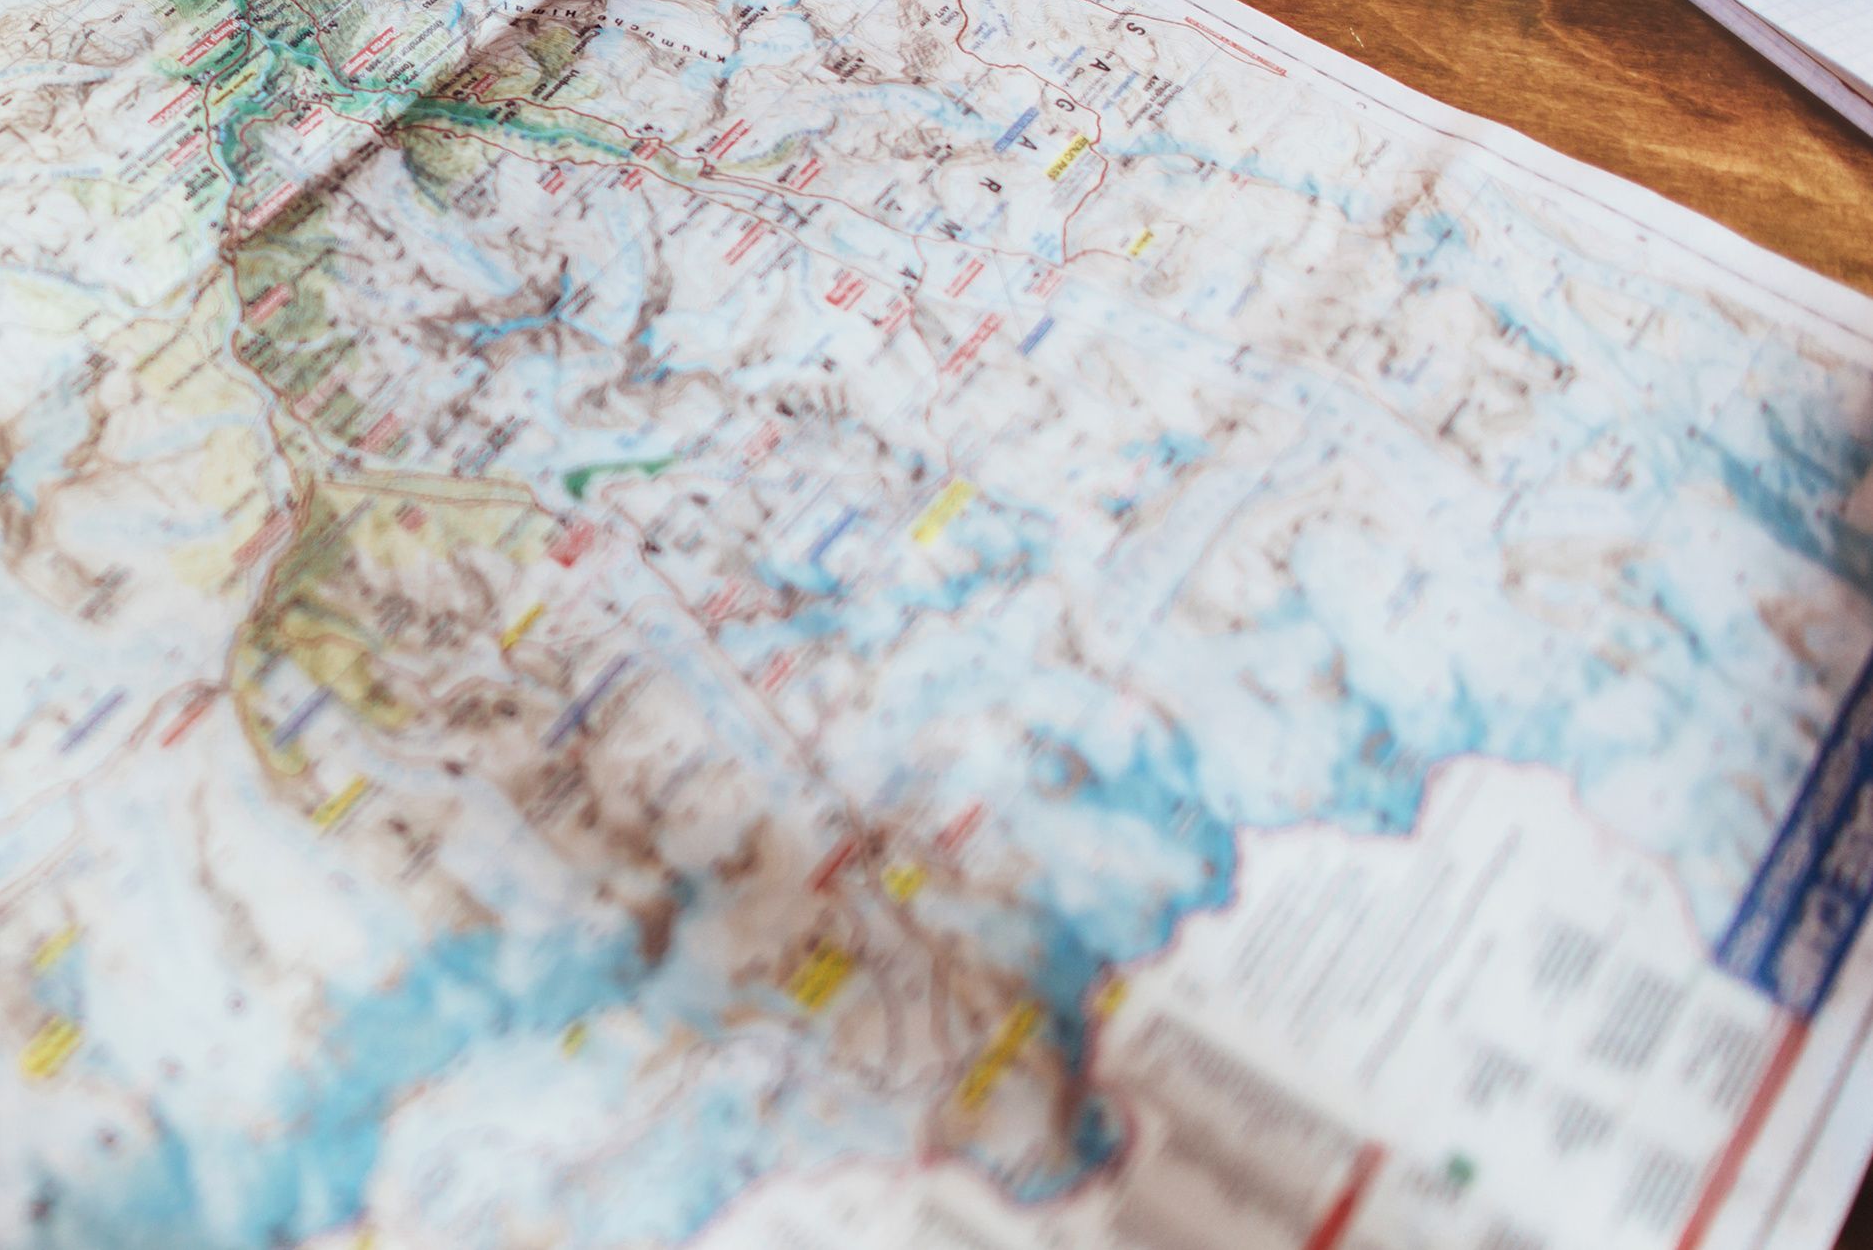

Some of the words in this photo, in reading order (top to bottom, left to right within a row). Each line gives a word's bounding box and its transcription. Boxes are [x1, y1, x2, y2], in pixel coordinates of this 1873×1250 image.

[398, 17, 443, 57] Rhododendron
[540, 67, 579, 102] Lhabarma
[1061, 135, 1088, 162] RENJO
[1045, 157, 1066, 179] PASS
